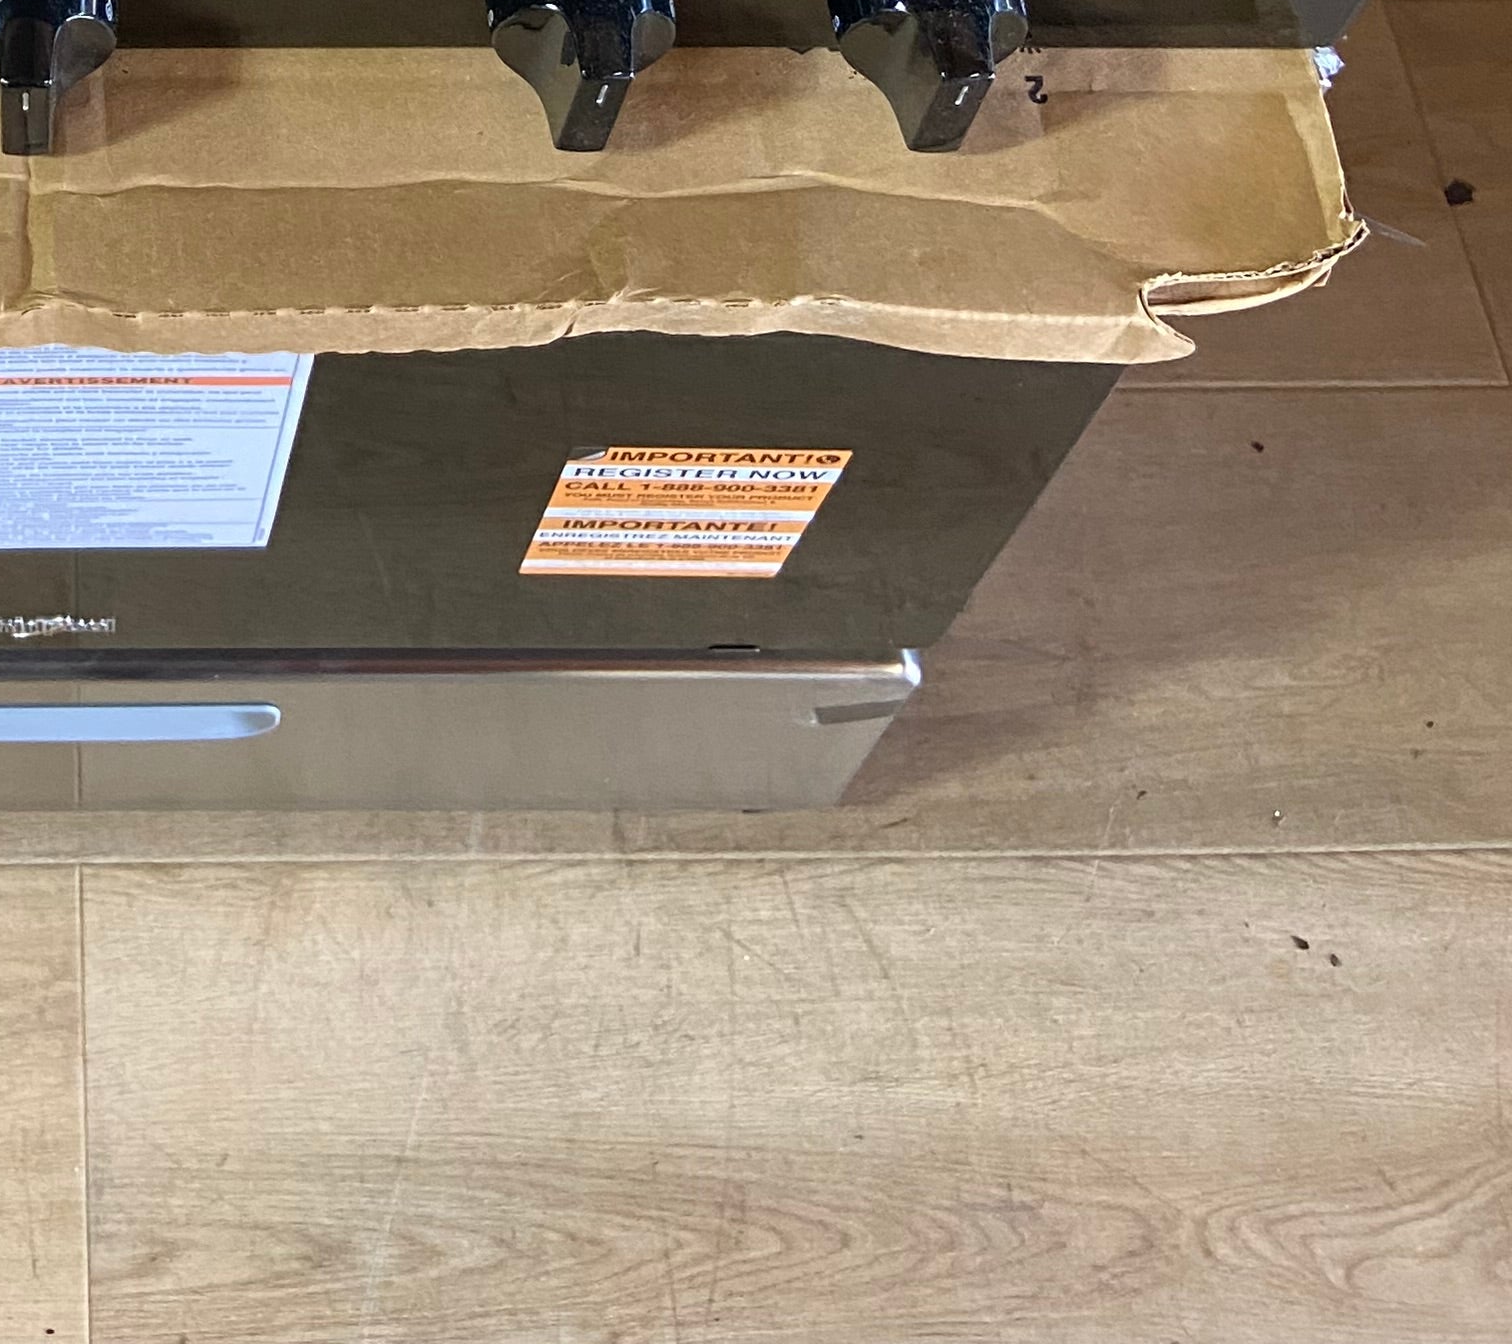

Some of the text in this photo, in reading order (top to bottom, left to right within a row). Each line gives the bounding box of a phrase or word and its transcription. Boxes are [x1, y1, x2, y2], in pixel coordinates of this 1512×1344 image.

[1, 376, 194, 386] AVERTISSEMENT
[609, 450, 814, 464] IMPORTANT!
[574, 467, 829, 480] REGISTER NOW
[565, 481, 820, 494] CALL 1-888-900-3381
[562, 519, 778, 532] IMPORTANTE!
[539, 531, 793, 542] ENREGISTREZ MAINTENANT
